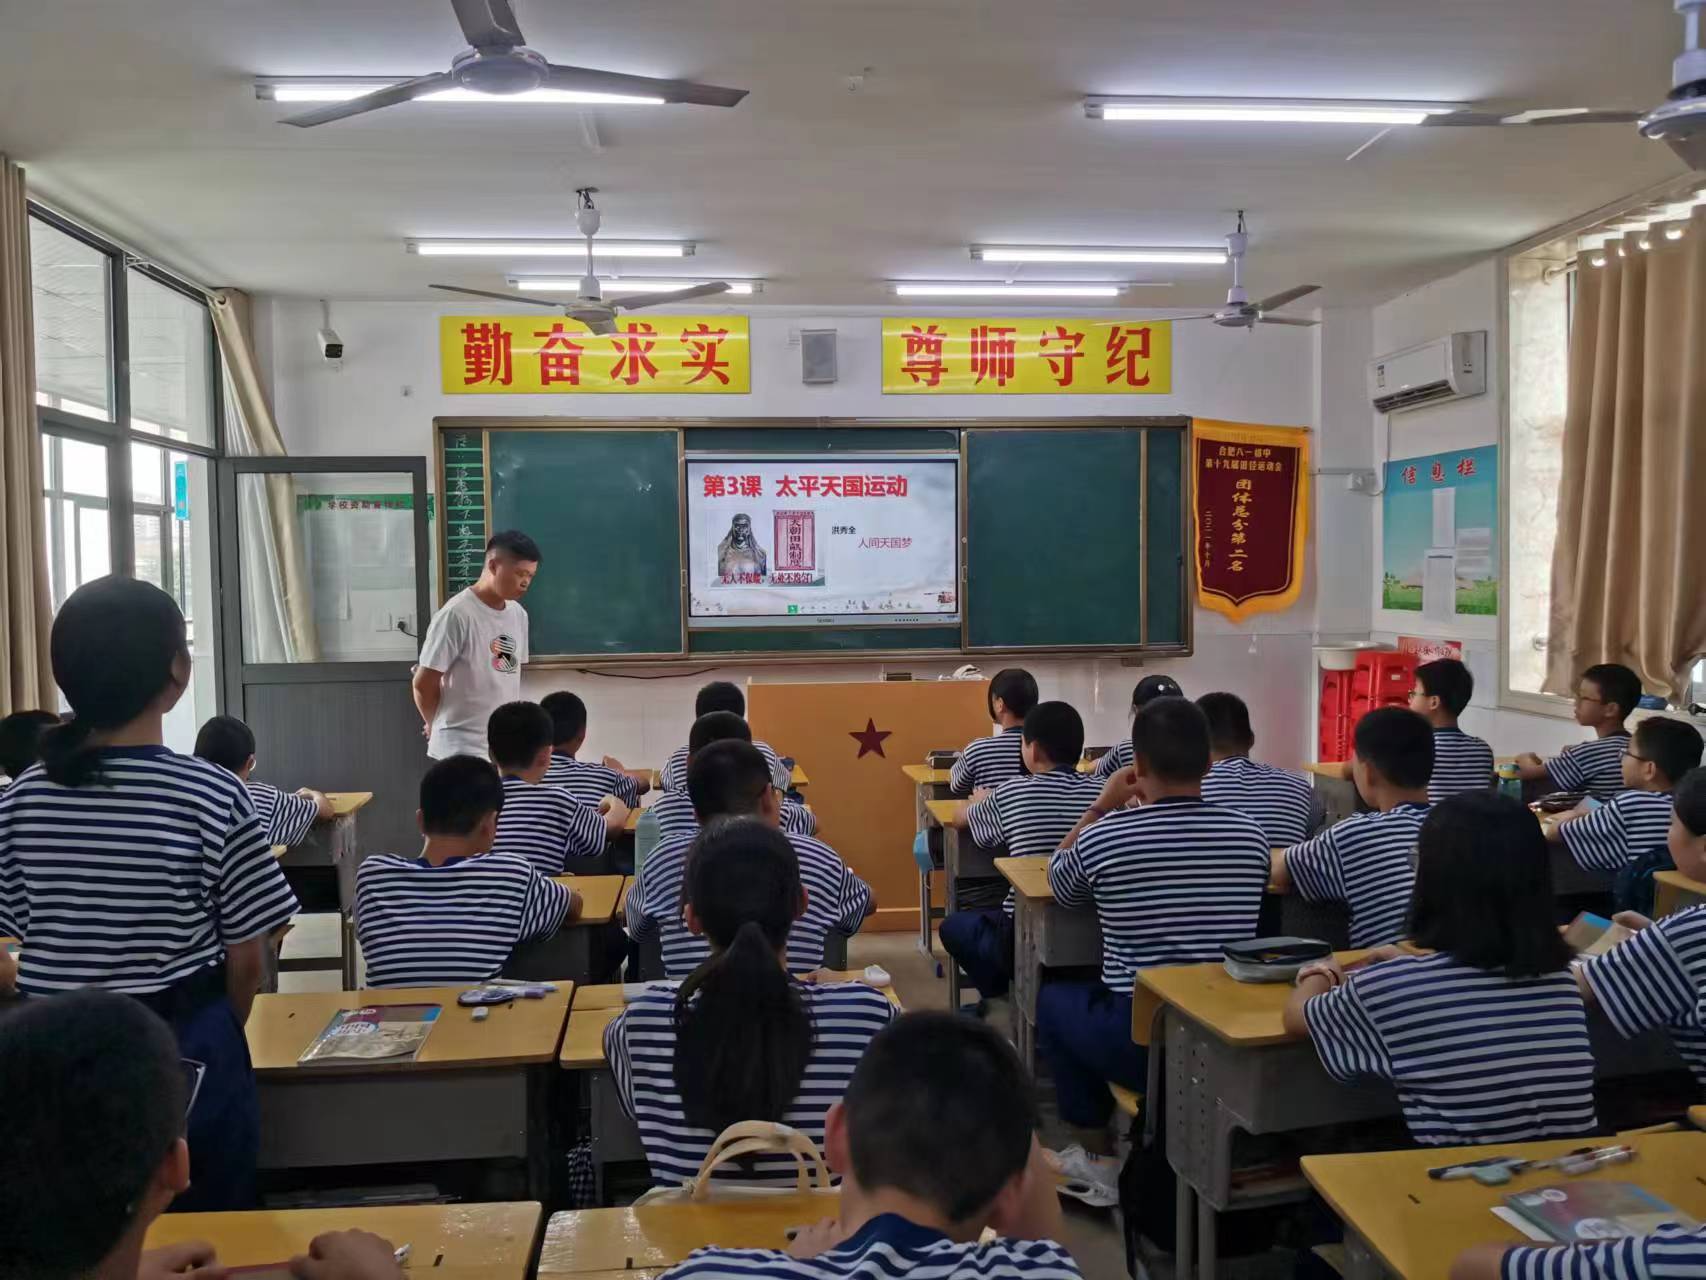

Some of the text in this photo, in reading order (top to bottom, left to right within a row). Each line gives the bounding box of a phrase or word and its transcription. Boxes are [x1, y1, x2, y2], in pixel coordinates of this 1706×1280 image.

[461, 322, 730, 386] 勤奋求实
[901, 325, 1152, 387] 尊师守纪
[1401, 458, 1477, 484] 信息栏
[703, 474, 908, 498] 第3课 太平天国运动
[831, 525, 857, 535] 洪秀全
[858, 537, 912, 549] 人间天国梦
